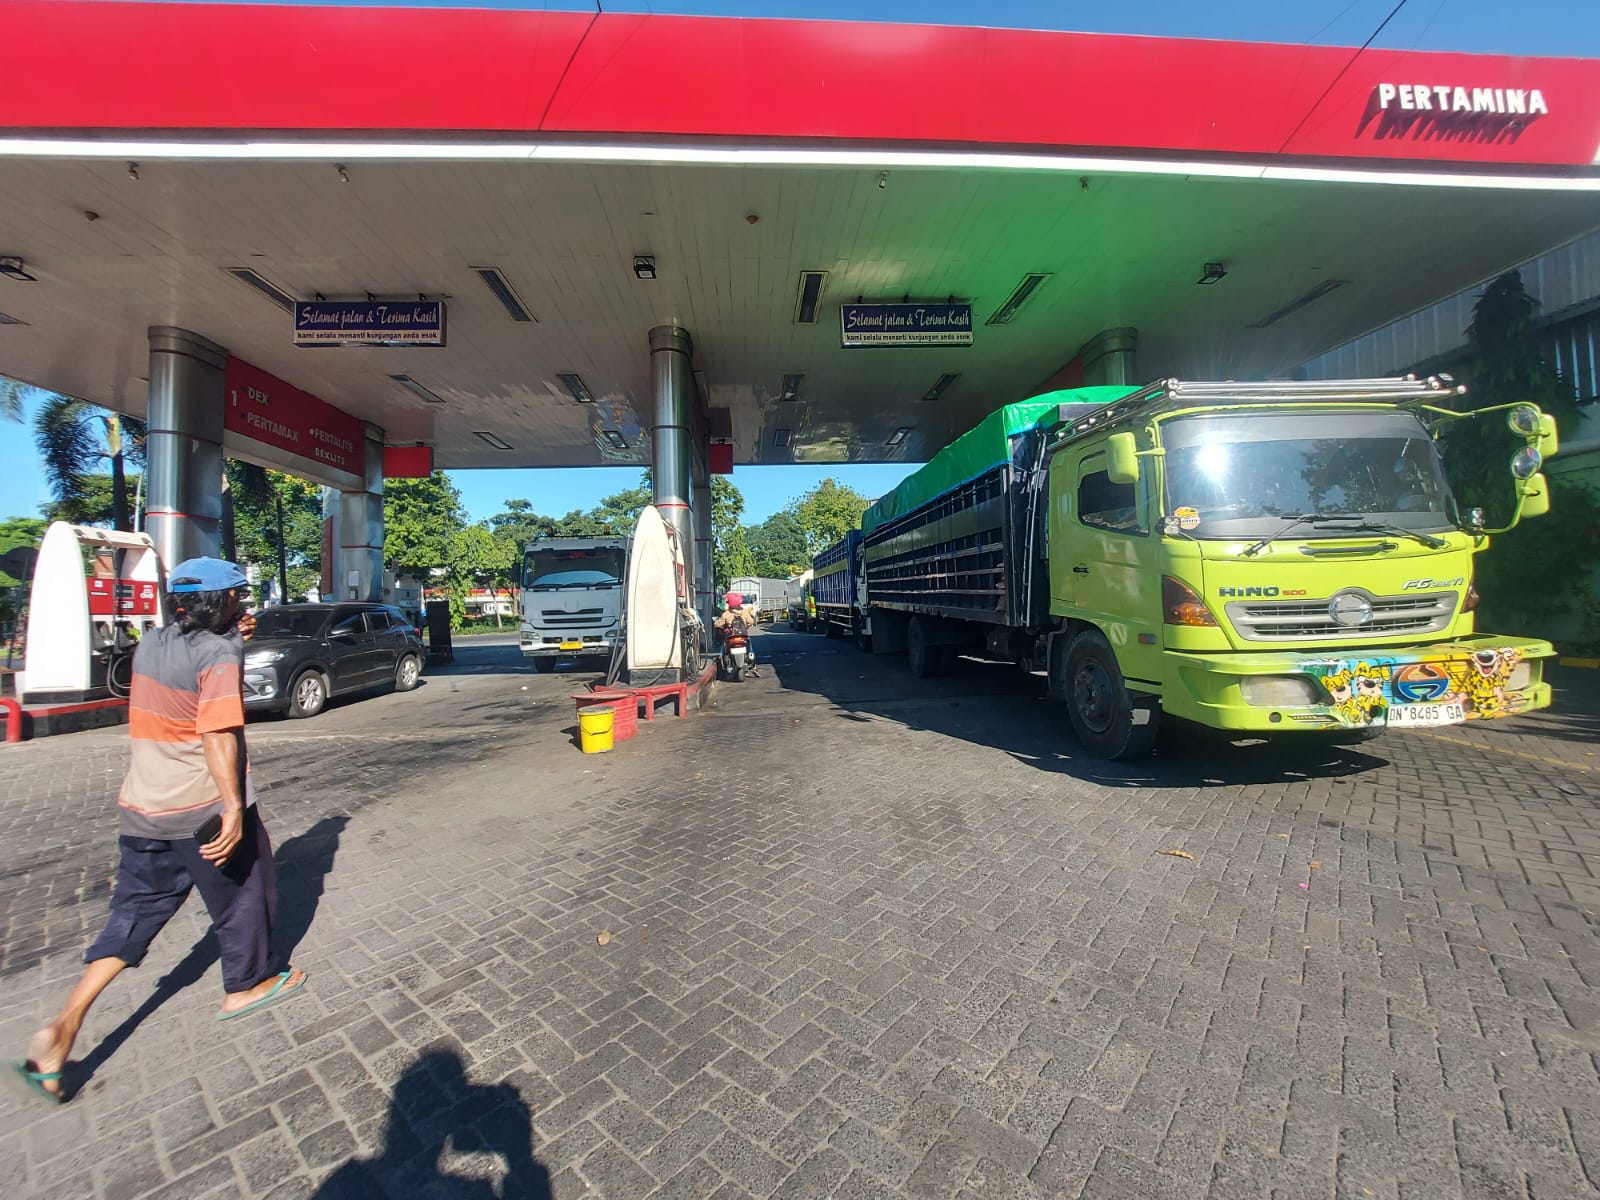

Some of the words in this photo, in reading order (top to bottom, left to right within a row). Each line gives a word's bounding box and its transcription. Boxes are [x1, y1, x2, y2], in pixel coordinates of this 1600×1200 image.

[1378, 83, 1548, 114] PERTAMINA
[299, 306, 339, 326] Selamat
[341, 310, 364, 328] jalan
[366, 310, 374, 323] &
[376, 306, 410, 325] Terima
[413, 306, 437, 323] Kasih
[847, 310, 883, 329] Selamat
[885, 313, 905, 331] jalan
[906, 313, 914, 326] &
[915, 309, 946, 327] Terima
[947, 309, 969, 326] Kasih
[367, 332, 402, 340] kunjungan
[231, 390, 238, 407] 1
[248, 387, 269, 405] DEX
[247, 412, 299, 442] PERTAMAX
[314, 428, 353, 453] PERTALITE
[1219, 586, 1279, 597] HINO
[1390, 707, 1402, 721] DN
[1410, 706, 1439, 720] 8485
[1447, 705, 1462, 720] GA
